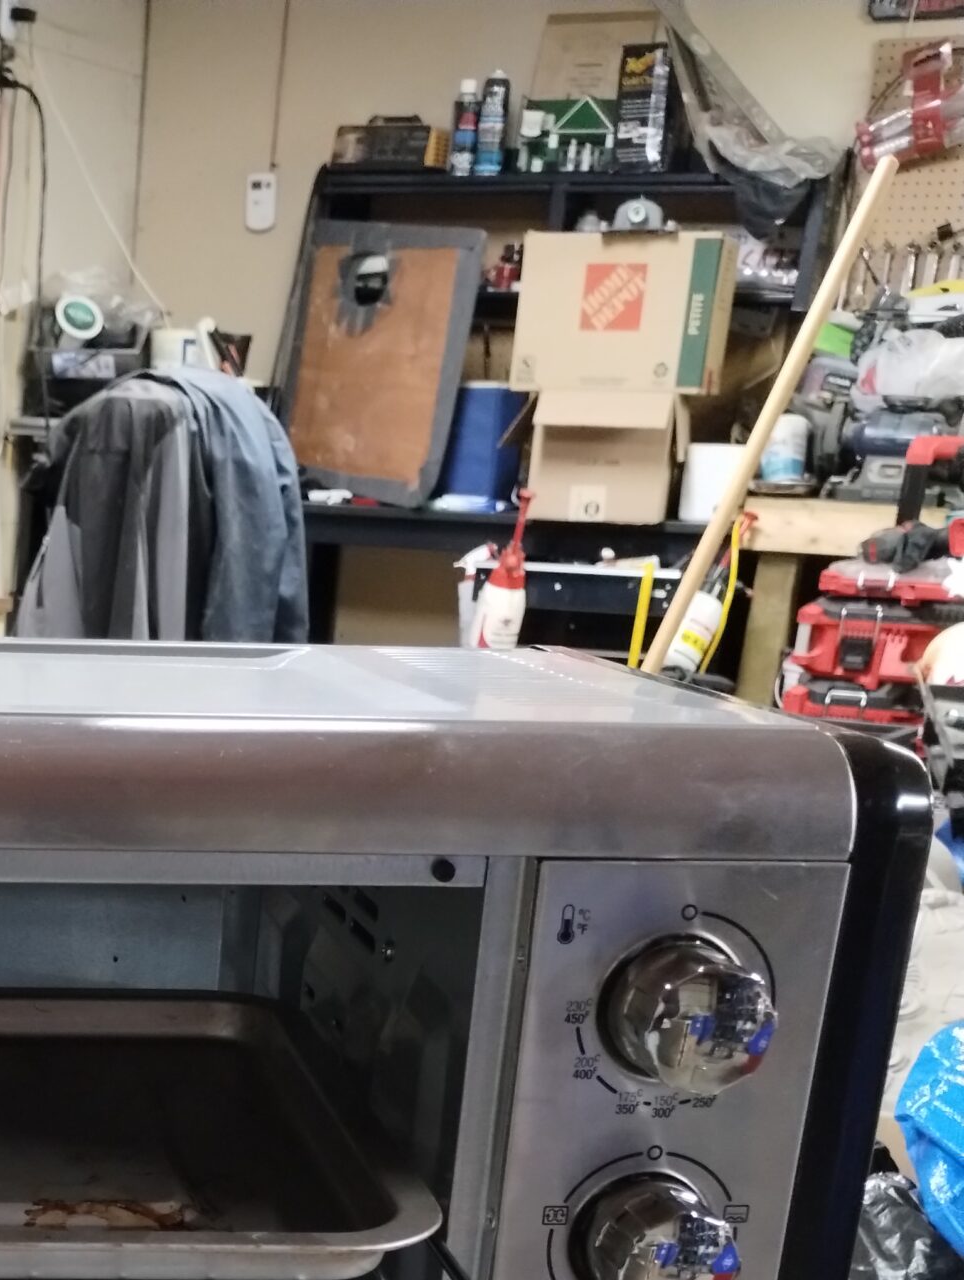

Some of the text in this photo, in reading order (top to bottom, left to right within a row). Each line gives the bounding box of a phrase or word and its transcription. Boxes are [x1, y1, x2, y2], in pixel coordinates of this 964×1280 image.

[582, 264, 631, 315] HOME
[591, 272, 647, 331] DEPOT
[687, 292, 705, 335] PETITE
